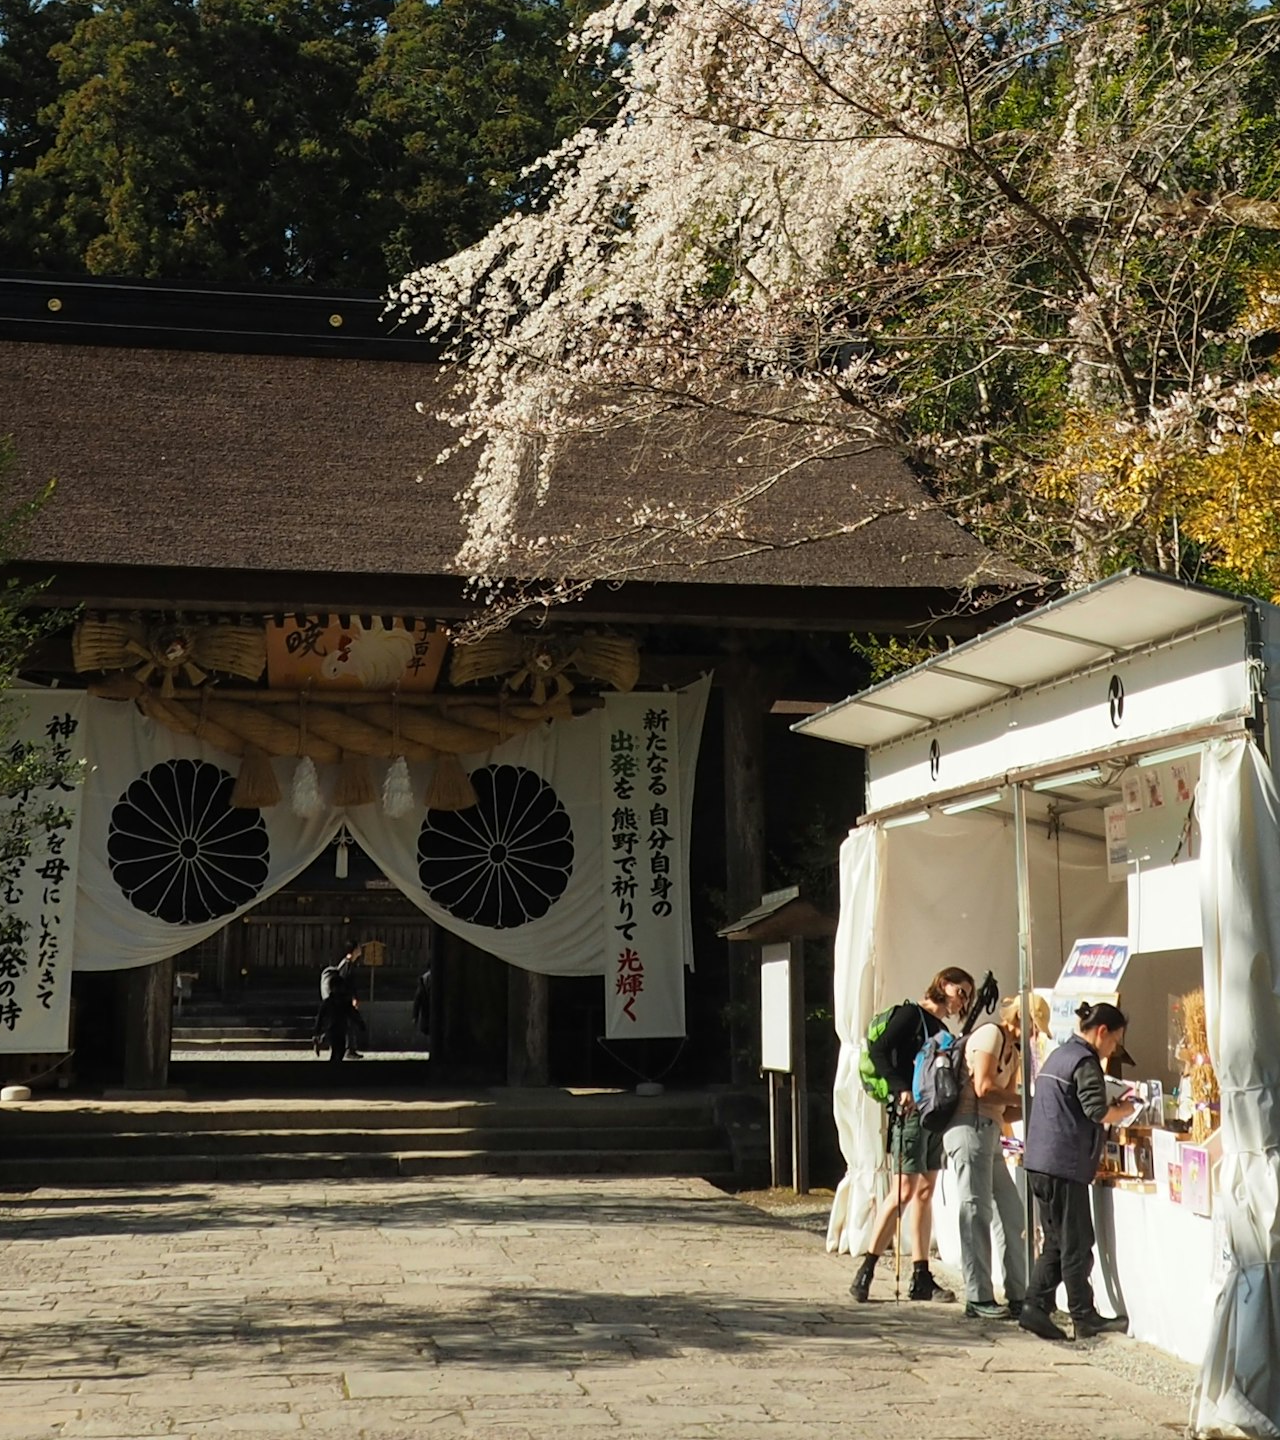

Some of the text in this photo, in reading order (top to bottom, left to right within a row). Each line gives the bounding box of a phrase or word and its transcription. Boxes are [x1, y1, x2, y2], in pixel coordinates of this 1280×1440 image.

[609, 728, 645, 1023] 出発を 熊野で祈りて 光輝く
[642, 708, 675, 917] 新たなる 自分自身の
